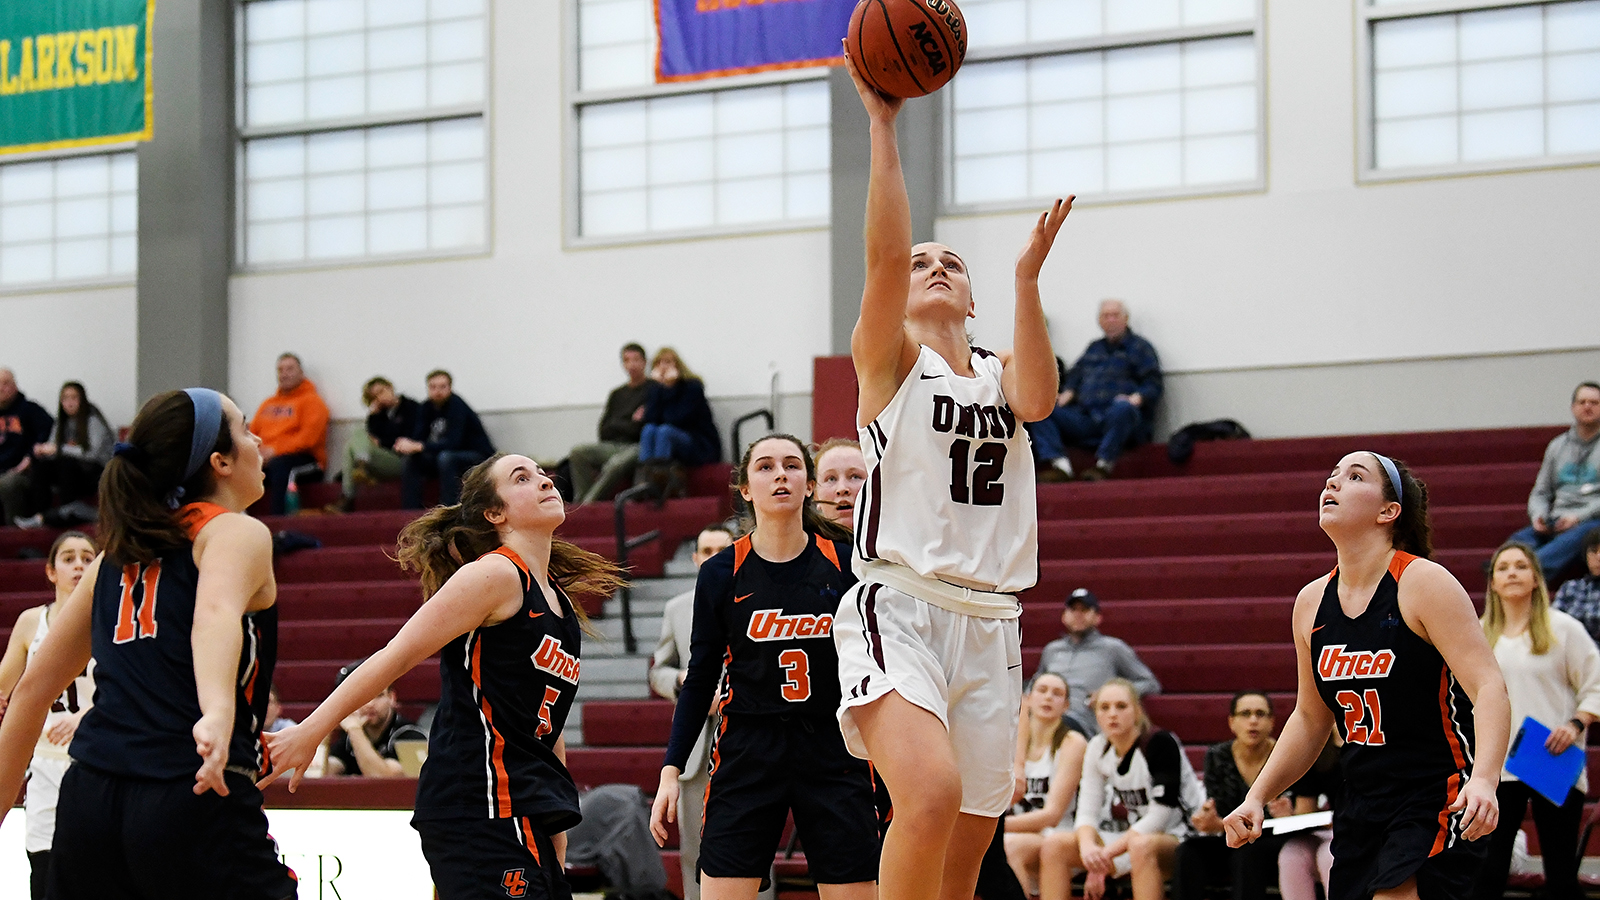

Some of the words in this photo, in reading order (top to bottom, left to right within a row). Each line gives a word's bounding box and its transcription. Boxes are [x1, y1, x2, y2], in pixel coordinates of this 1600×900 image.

[909, 21, 947, 77] NCAA
[948, 438, 1009, 507] 12
[113, 557, 163, 644] 11
[746, 608, 834, 642] UTICA
[530, 634, 581, 686] UTICA
[778, 649, 811, 702] 3
[1317, 644, 1396, 681] UTICA
[534, 684, 561, 740] 5
[1335, 688, 1386, 746] 21
[500, 868, 529, 898] UC
